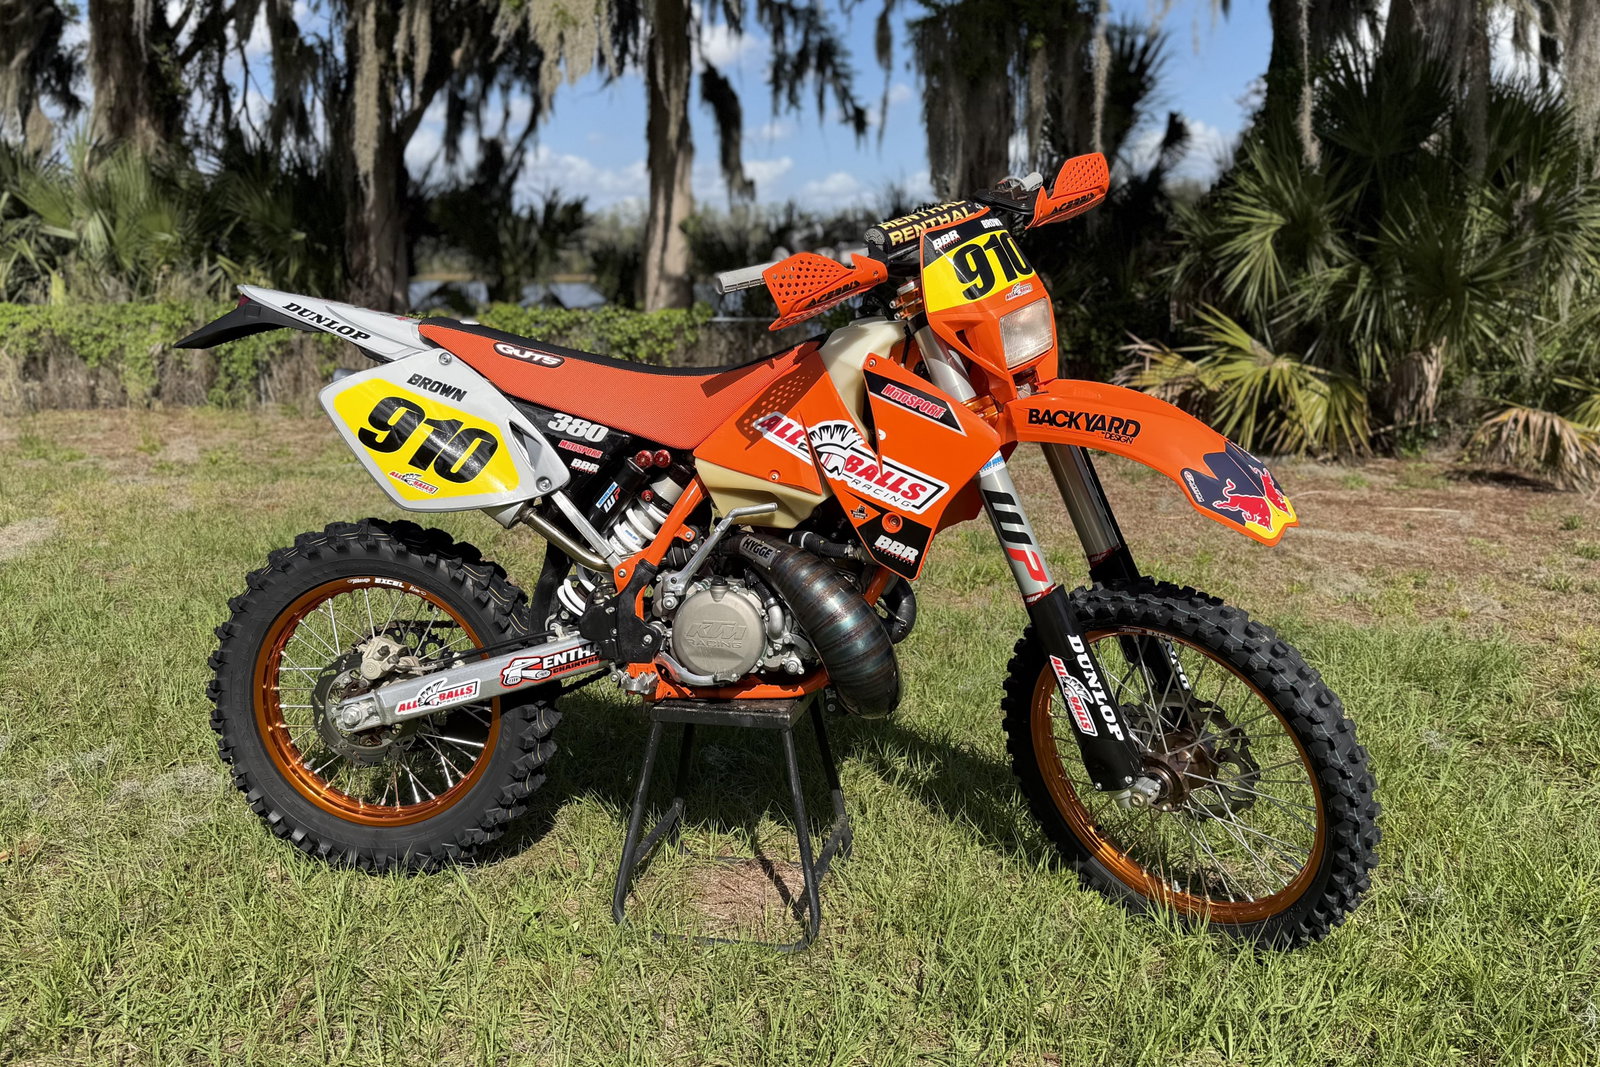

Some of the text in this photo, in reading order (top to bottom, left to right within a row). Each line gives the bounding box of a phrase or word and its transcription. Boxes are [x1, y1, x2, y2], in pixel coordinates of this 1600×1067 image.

[888, 206, 976, 247] RENTHAL
[932, 230, 961, 251] BBR
[952, 232, 1034, 301] 910
[282, 302, 371, 342] DUNLOP
[495, 343, 562, 365] GUTS
[406, 373, 468, 402] BROWN
[547, 412, 609, 442] 380
[1027, 408, 1142, 438] BACKYARD
[1104, 431, 1134, 445] DESIGN
[358, 396, 498, 484] 910
[570, 458, 600, 473] BBR
[757, 415, 928, 501] ALL BALLS
[851, 478, 912, 508] RACING
[742, 538, 773, 559] HYGGE
[874, 534, 919, 563] BBR
[686, 620, 747, 640] KTM
[397, 685, 474, 713] ALL BALLS
[1050, 656, 1068, 677] ALL
[1070, 696, 1092, 730] BALLS
[1066, 634, 1125, 741] DUNLOP
